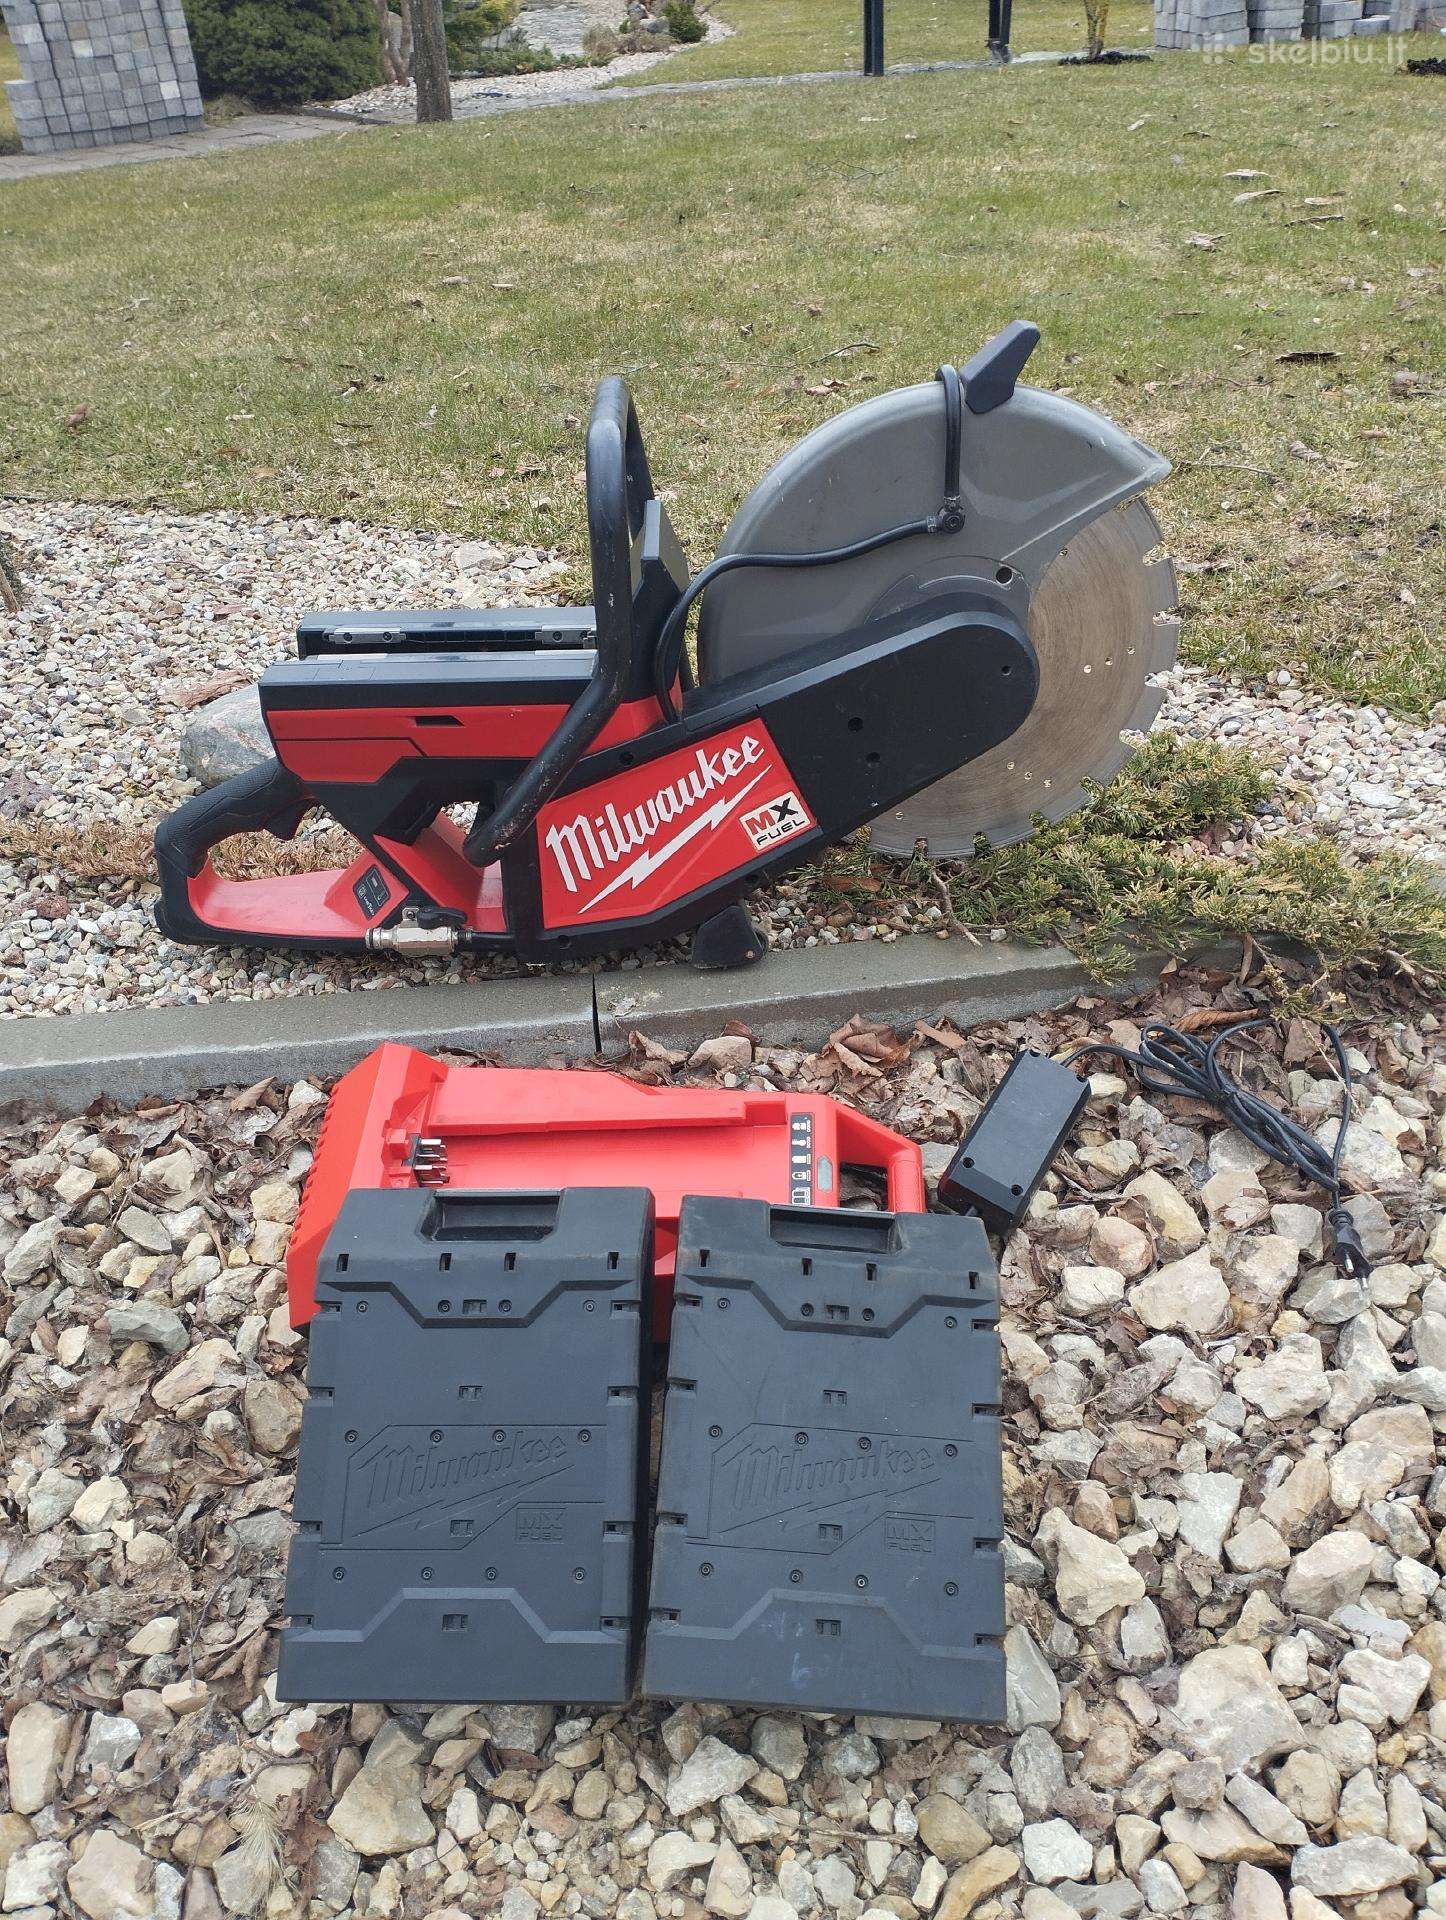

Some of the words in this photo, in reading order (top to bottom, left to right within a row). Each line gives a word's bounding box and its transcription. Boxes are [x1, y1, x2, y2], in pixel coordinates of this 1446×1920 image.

[545, 735, 765, 893] Milwaukee
[743, 796, 799, 838] MX
[756, 819, 806, 846] FUEL
[354, 1430, 568, 1509] Milwaukee
[721, 1438, 936, 1510] Milwaukee
